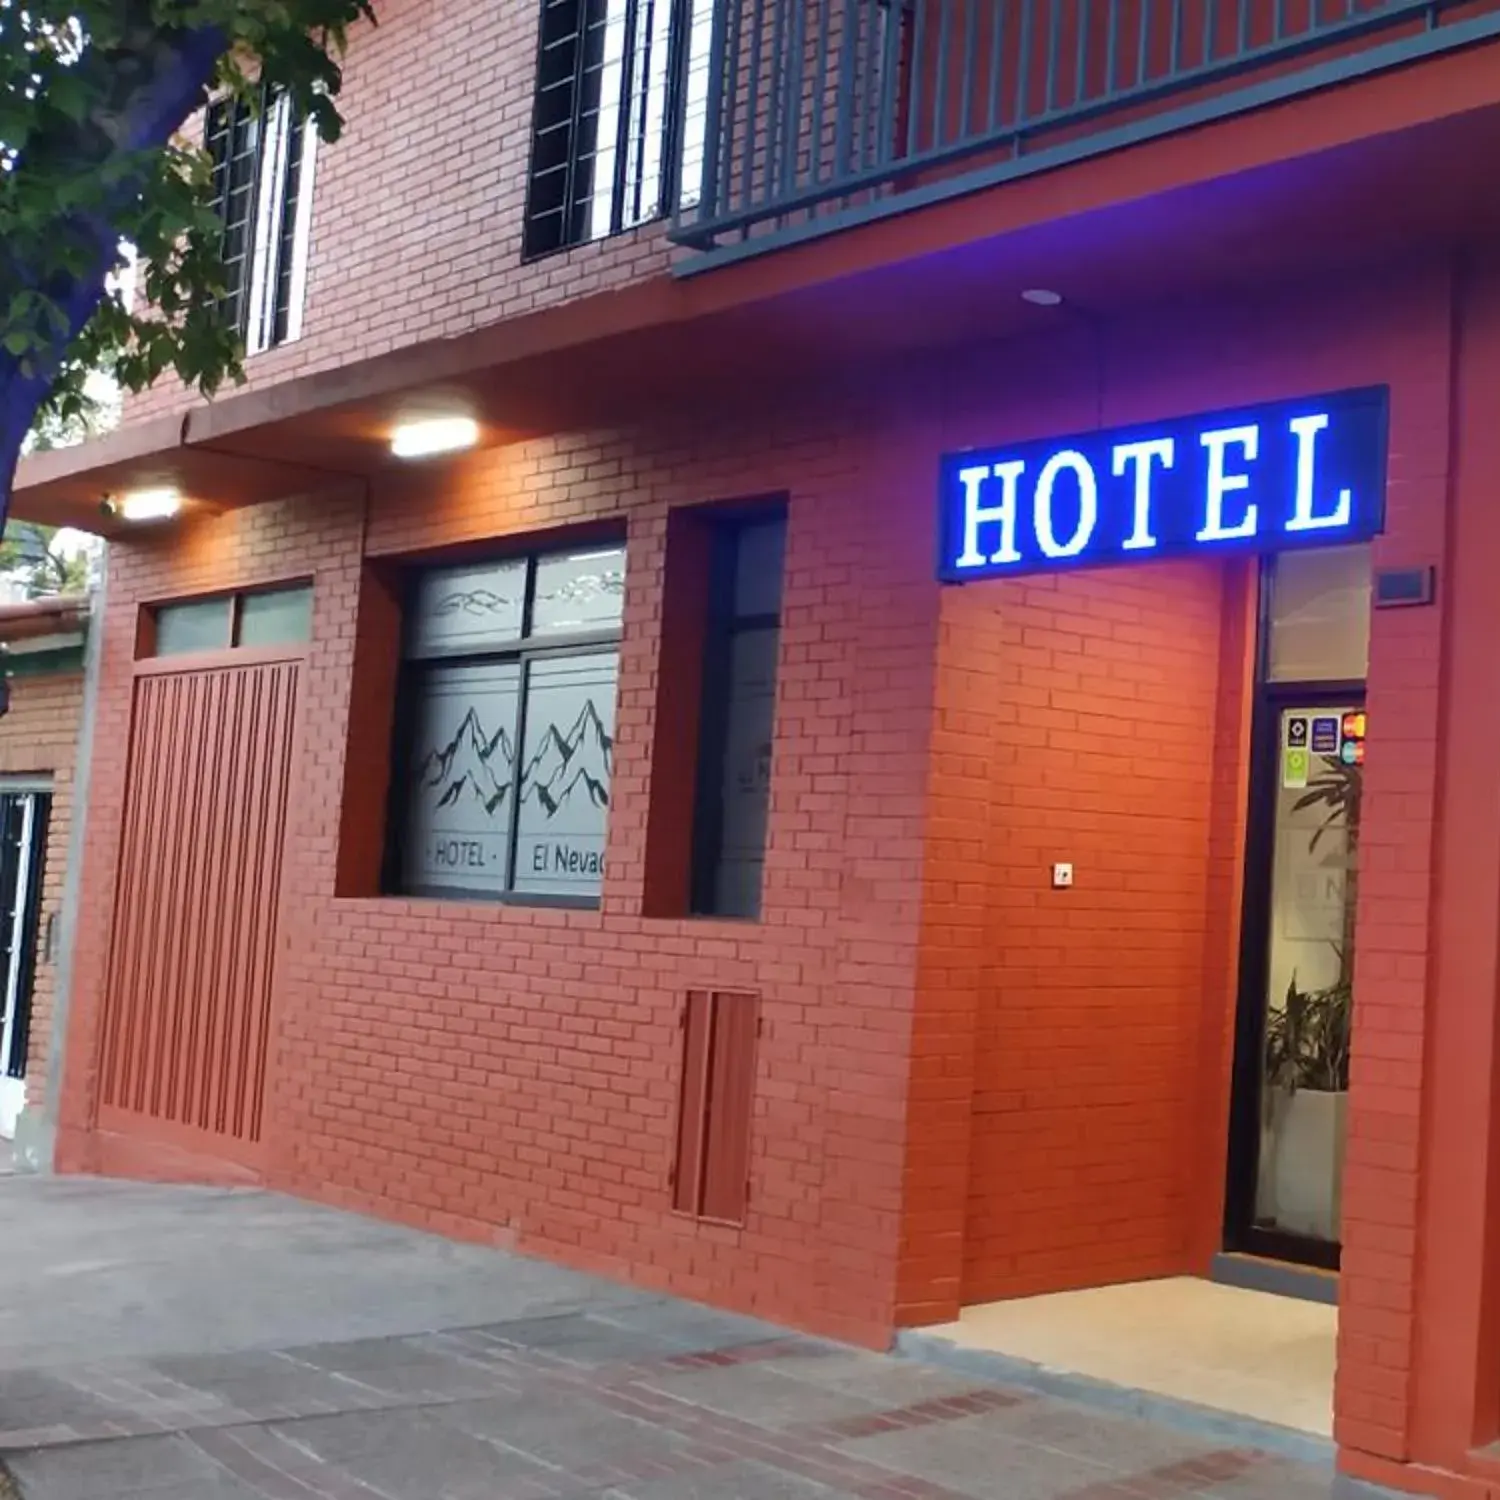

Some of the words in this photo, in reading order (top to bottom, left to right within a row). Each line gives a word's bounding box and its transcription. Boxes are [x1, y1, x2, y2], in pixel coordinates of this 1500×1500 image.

[956, 413, 1351, 568] HOTEL
[434, 840, 486, 867] HOTEL
[533, 844, 549, 871] El
[555, 843, 605, 875] Neva
